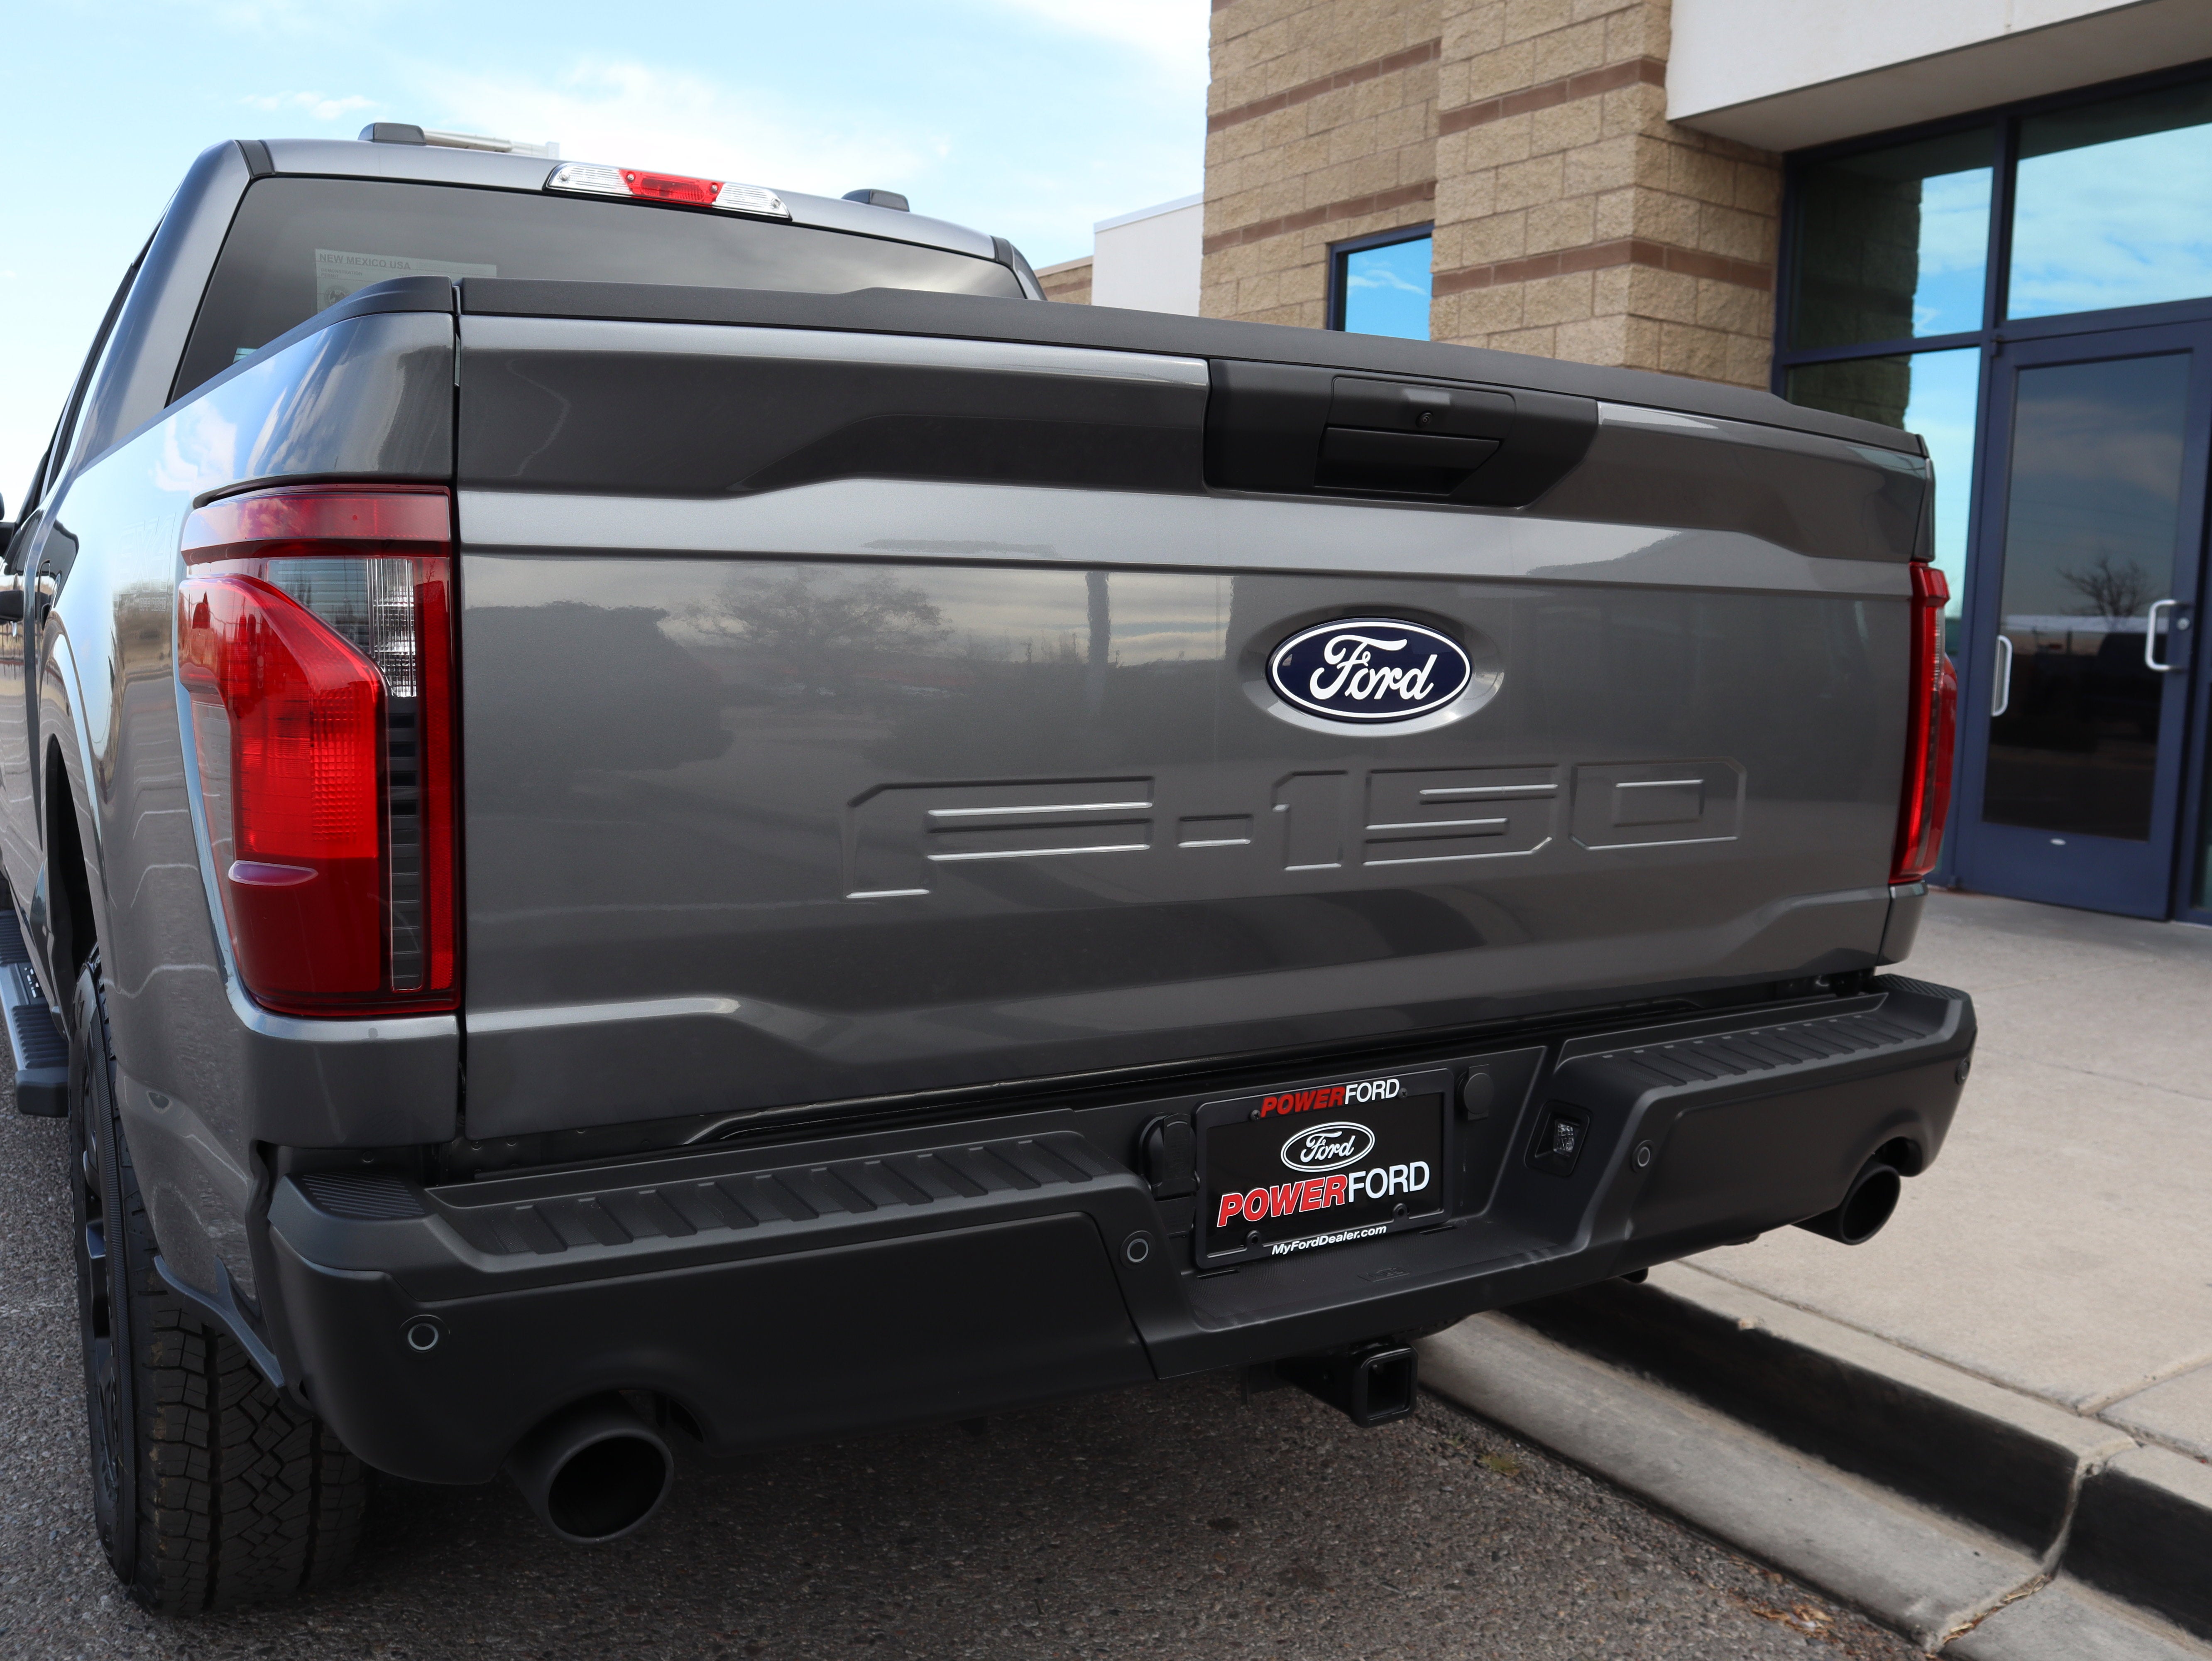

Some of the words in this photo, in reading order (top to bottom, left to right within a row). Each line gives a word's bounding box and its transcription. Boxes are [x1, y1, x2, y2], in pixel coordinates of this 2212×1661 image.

[320, 254, 343, 263] NEW
[347, 257, 387, 267] MEXICO
[390, 261, 411, 269] USA
[1309, 635, 1437, 701] Ford
[847, 757, 1746, 899] F-150
[1300, 1131, 1356, 1162] Ford
[1272, 1226, 1387, 1255] MyFordDealer.com
